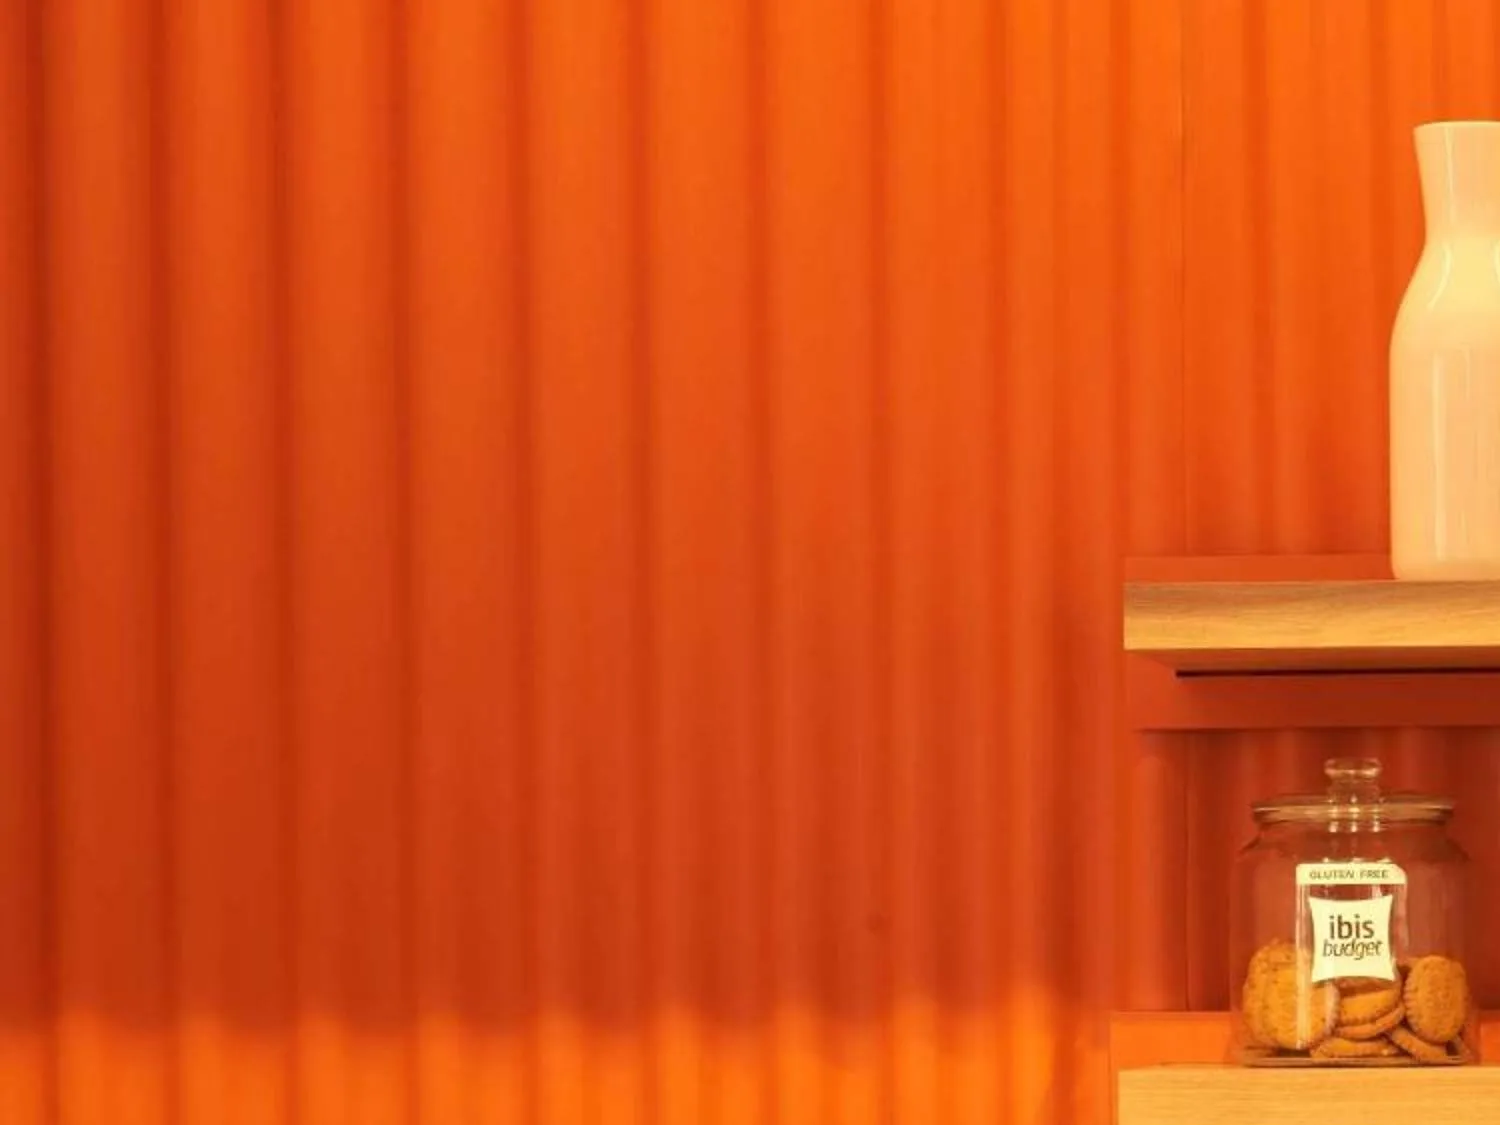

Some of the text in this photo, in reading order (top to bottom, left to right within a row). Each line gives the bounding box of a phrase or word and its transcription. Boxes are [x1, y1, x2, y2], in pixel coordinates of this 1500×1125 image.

[1310, 869, 1389, 879] GLUTEN FREE
[1329, 914, 1375, 939] ibis
[1322, 939, 1383, 960] budget
